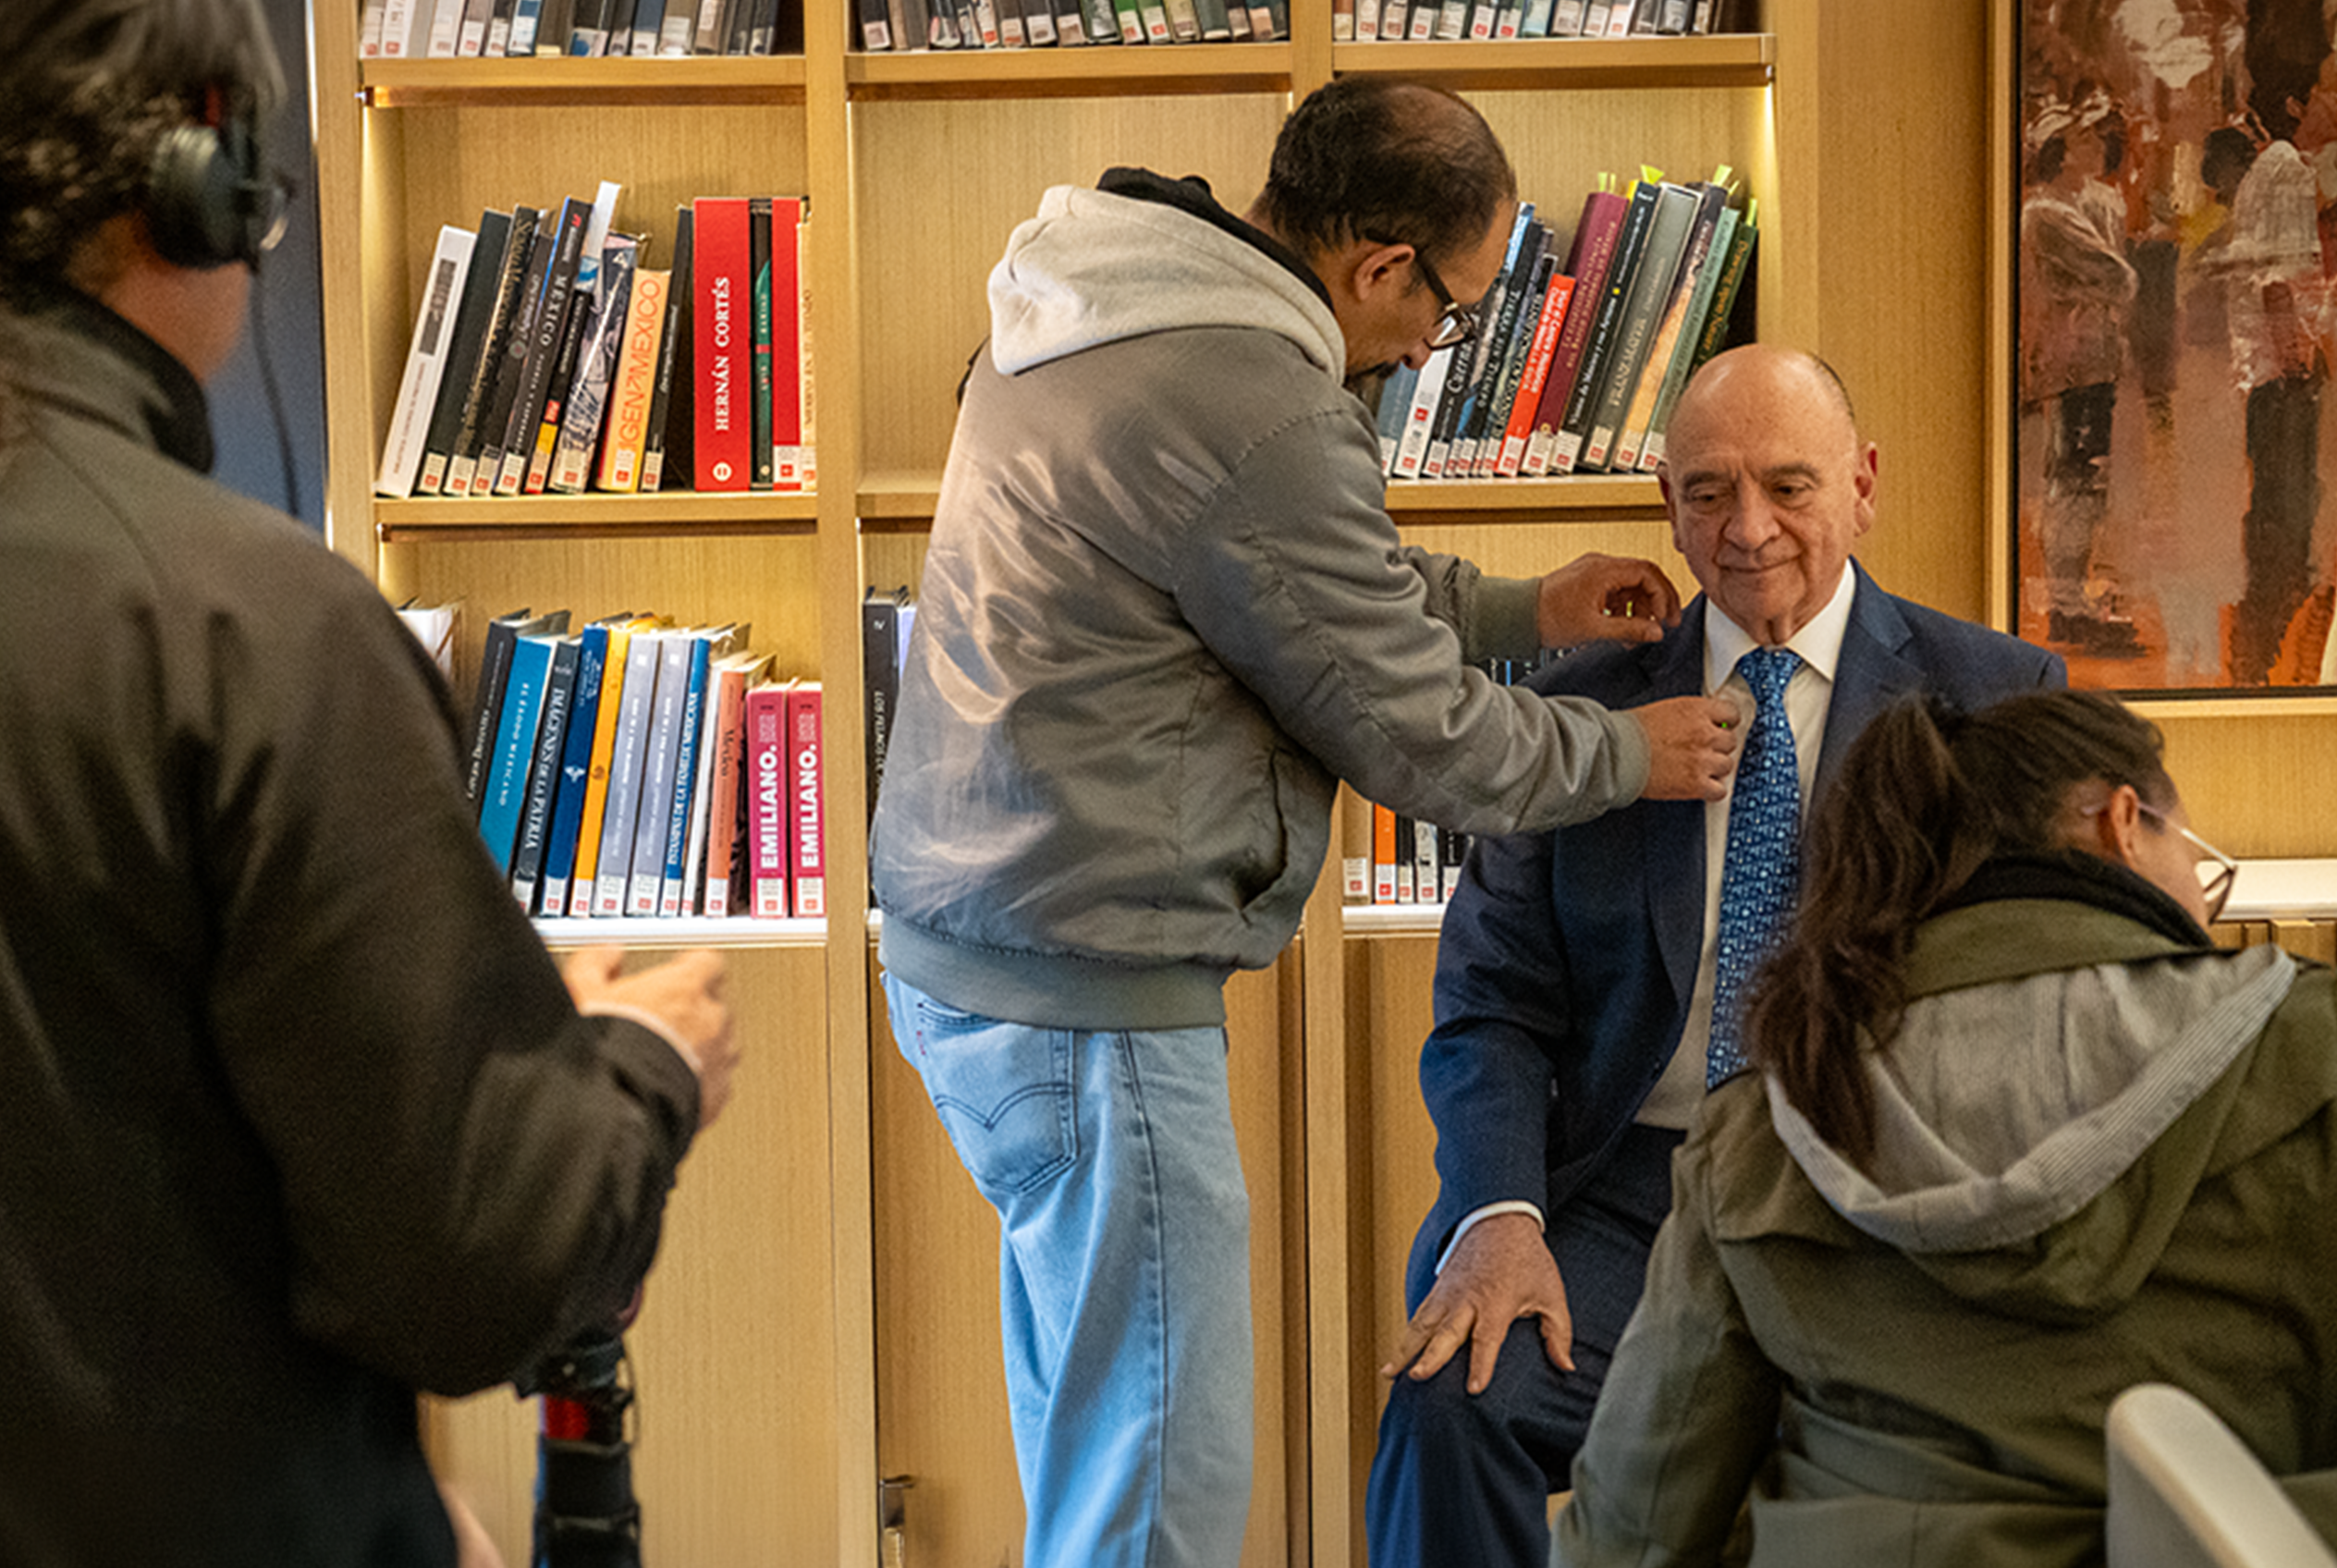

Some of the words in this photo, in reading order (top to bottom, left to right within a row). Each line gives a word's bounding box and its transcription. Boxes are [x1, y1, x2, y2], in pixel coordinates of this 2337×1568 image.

[537, 273, 568, 347] MÉXICO
[711, 276, 728, 347] CORTÉS
[1498, 288, 1522, 335] TIERRA
[1542, 318, 1560, 351] Centro
[1491, 337, 1505, 358] SIN
[711, 355, 728, 430] HERNÁN
[1475, 359, 1500, 410] TIEMPO
[539, 687, 569, 765] IMÁGENES
[496, 742, 518, 806] MEXICANO
[758, 743, 778, 868] EMILIANO.
[798, 743, 819, 867] EMILIANO.
[523, 796, 545, 850] PATRIA
